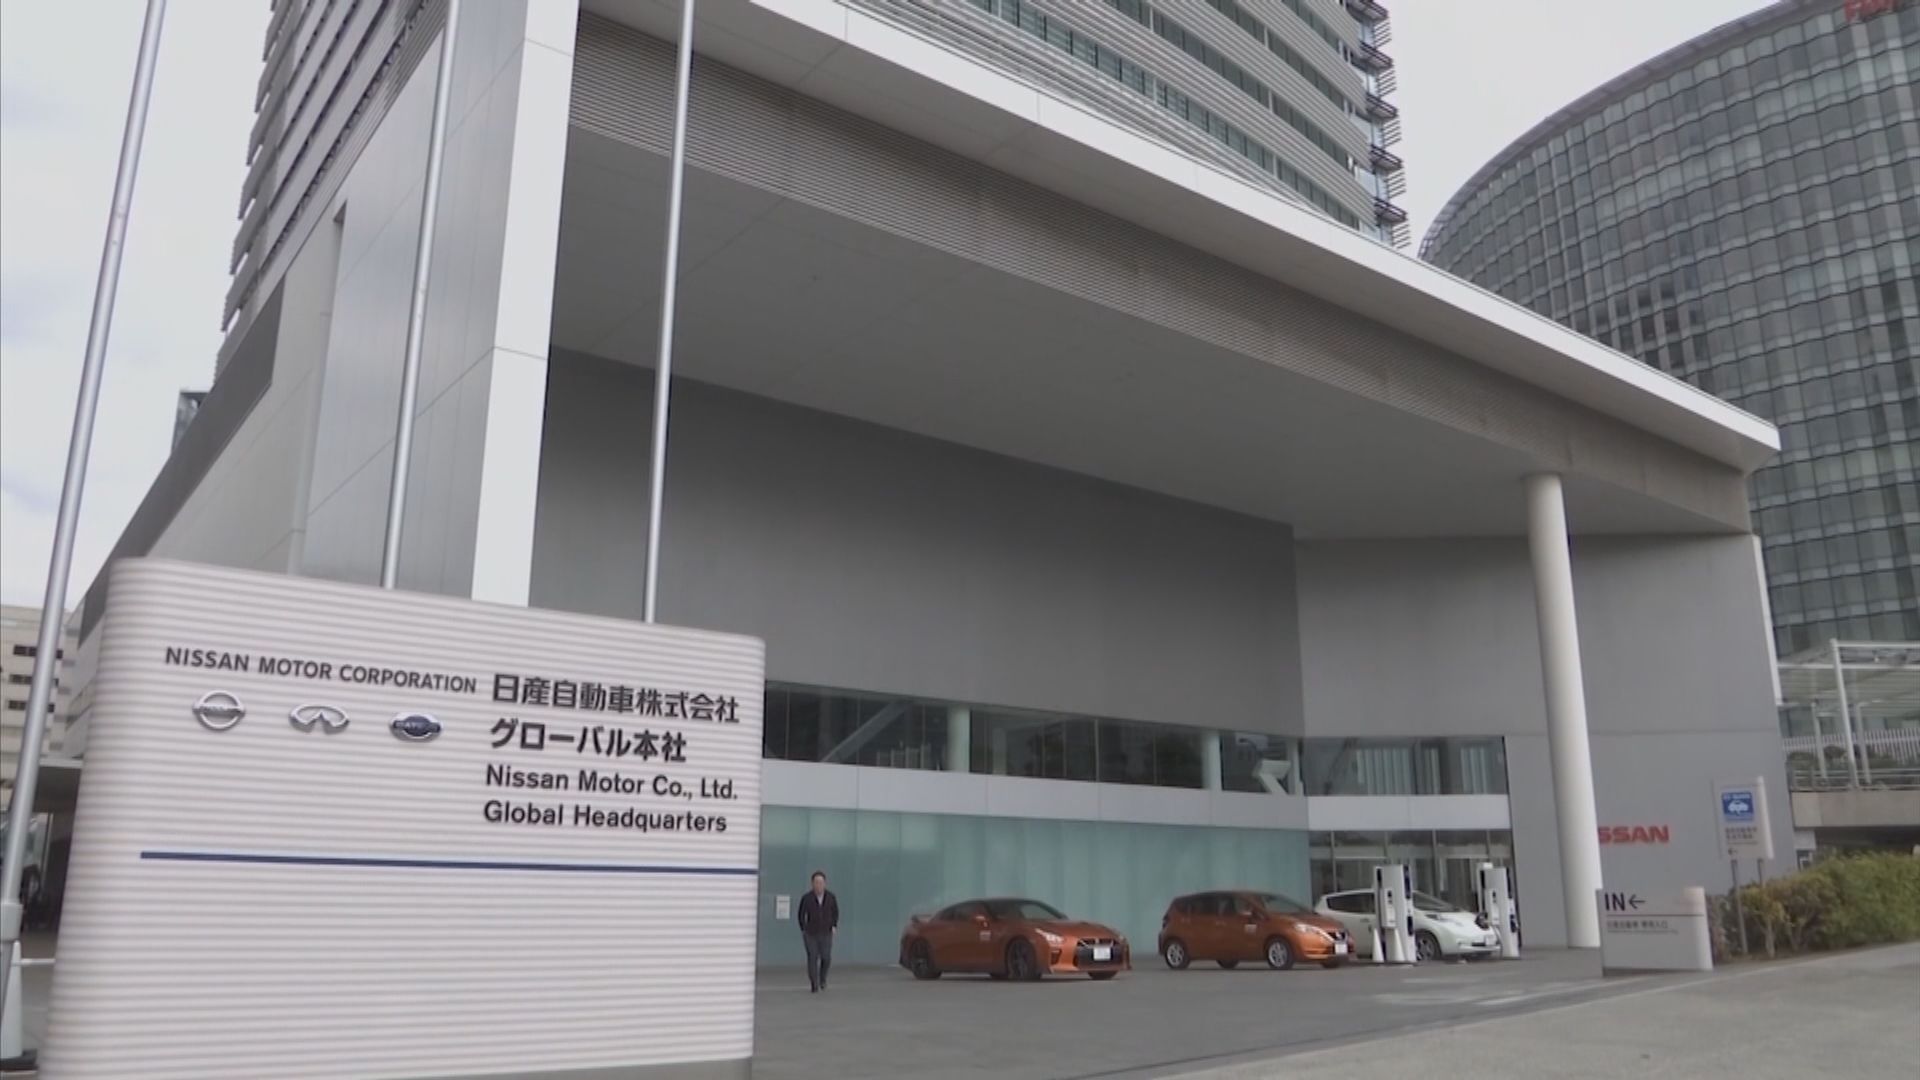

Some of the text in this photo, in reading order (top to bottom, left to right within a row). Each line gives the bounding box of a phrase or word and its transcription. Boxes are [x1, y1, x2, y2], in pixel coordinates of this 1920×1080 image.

[165, 647, 477, 693] NISSAN MOTOR CORPORATION
[493, 673, 740, 723] 日産自動車株式会社
[490, 718, 687, 762] グローバル本社
[486, 764, 738, 800] Nissan Motor Co., Ltd.
[484, 800, 727, 833] Global Headquarters
[1598, 825, 1669, 843] SSAN
[1605, 892, 1625, 911] IN
